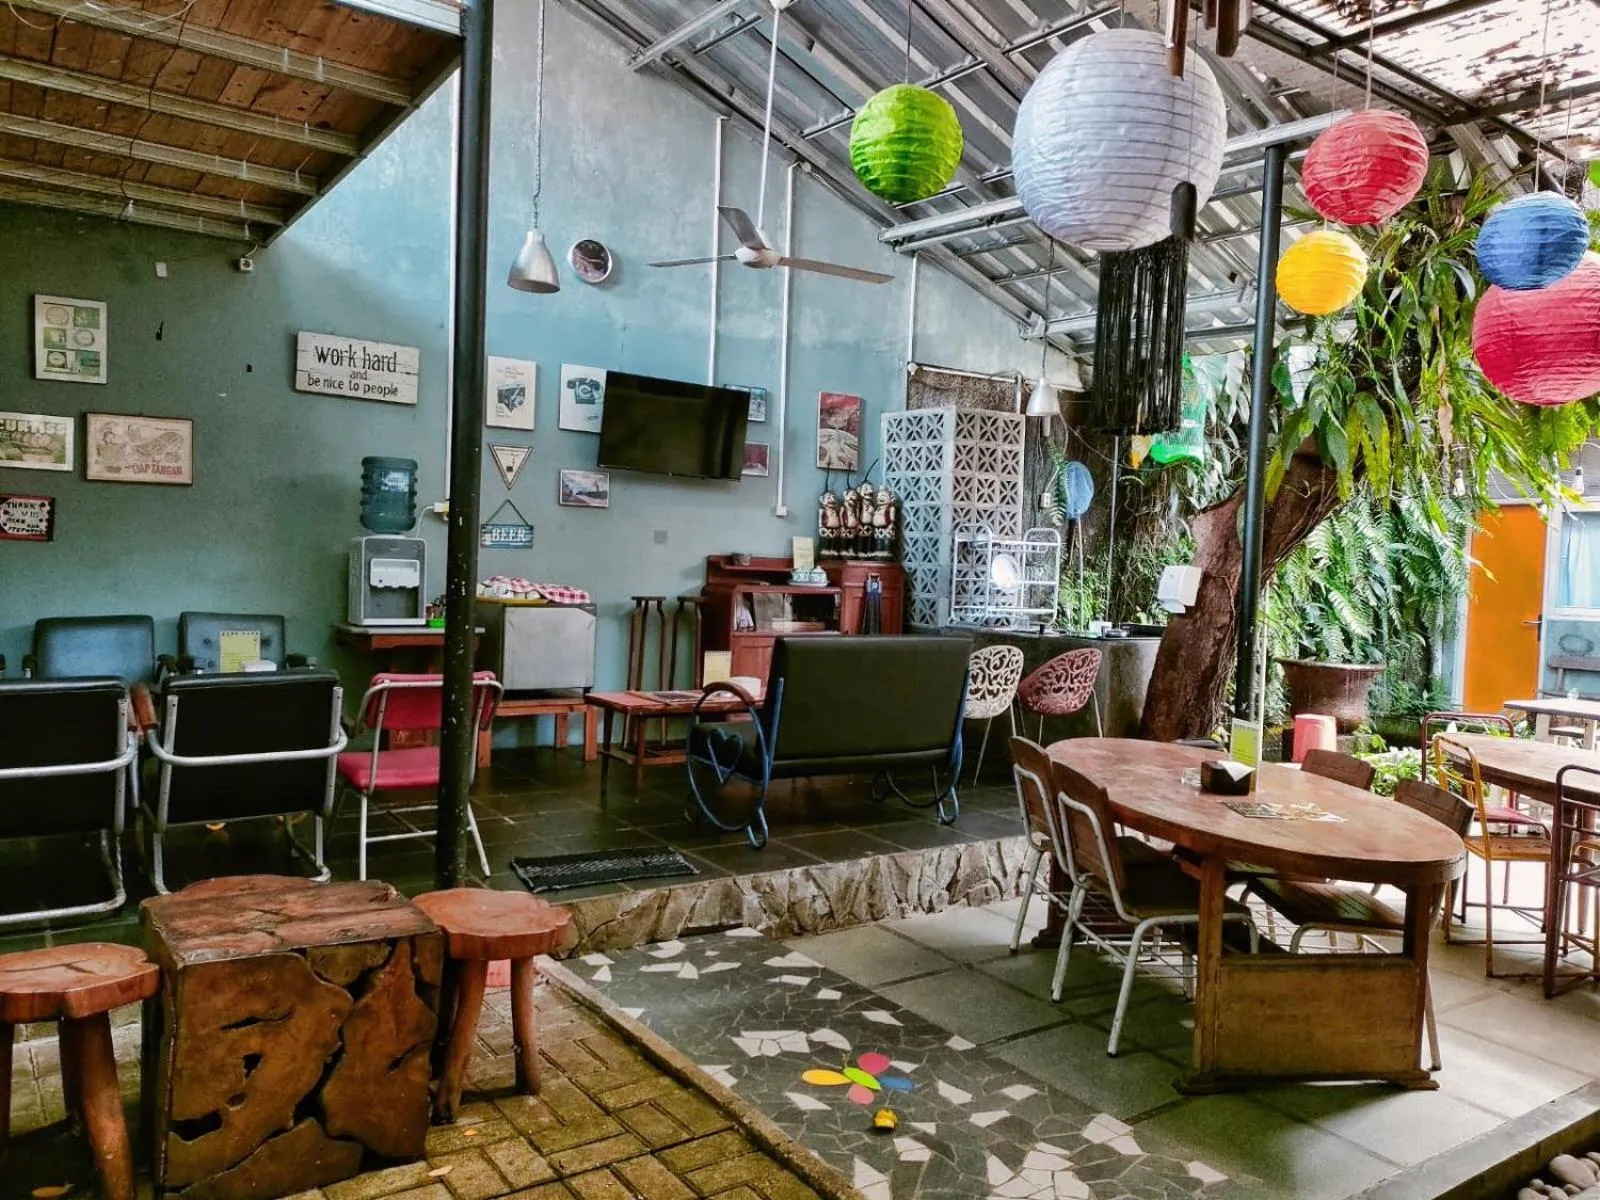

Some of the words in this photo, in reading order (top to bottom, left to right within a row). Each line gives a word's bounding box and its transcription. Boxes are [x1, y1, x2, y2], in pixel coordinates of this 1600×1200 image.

[314, 344, 357, 368] work
[362, 346, 397, 373] hard
[307, 373, 320, 386] be
[323, 376, 344, 389] nice
[349, 379, 359, 392] to
[363, 382, 399, 397] people
[350, 369, 368, 381] and
[491, 526, 527, 543] BEER
